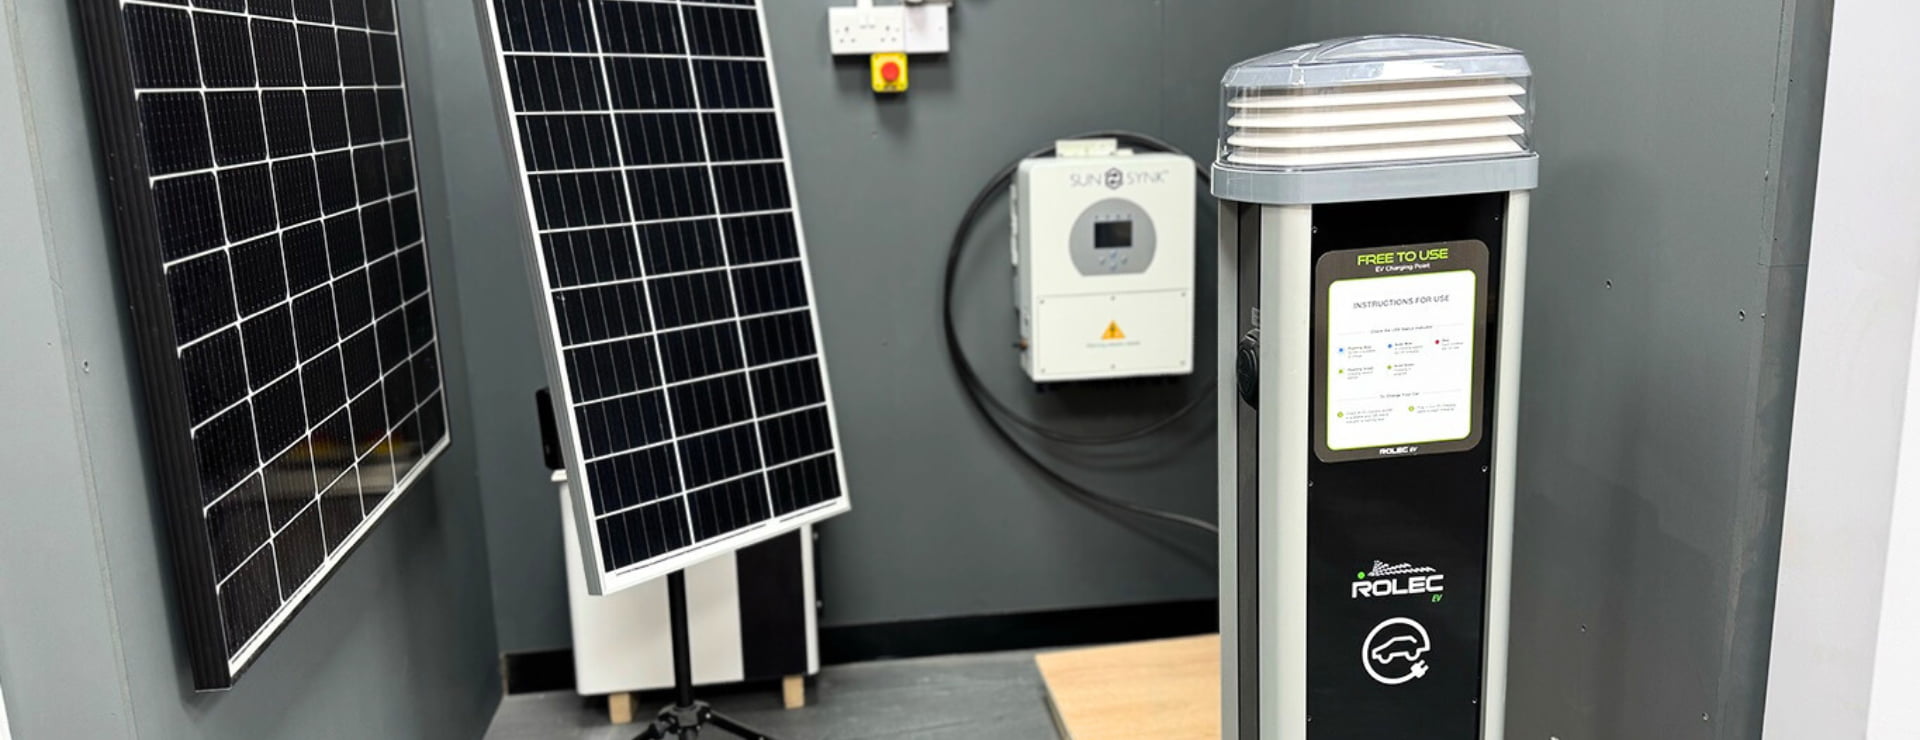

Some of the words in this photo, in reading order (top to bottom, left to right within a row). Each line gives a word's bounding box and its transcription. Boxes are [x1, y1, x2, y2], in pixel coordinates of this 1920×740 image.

[1357, 252, 1394, 265] FREE
[1397, 251, 1416, 262] TO
[1419, 248, 1448, 261] USE
[1385, 263, 1413, 272] Charging
[1353, 297, 1414, 309] INSTRUCTIONS
[1415, 296, 1432, 304] FOR
[1433, 294, 1449, 302] USE
[1379, 446, 1409, 455] ROLEC
[1351, 574, 1444, 599] ROLEC
[1431, 594, 1443, 603] EV
